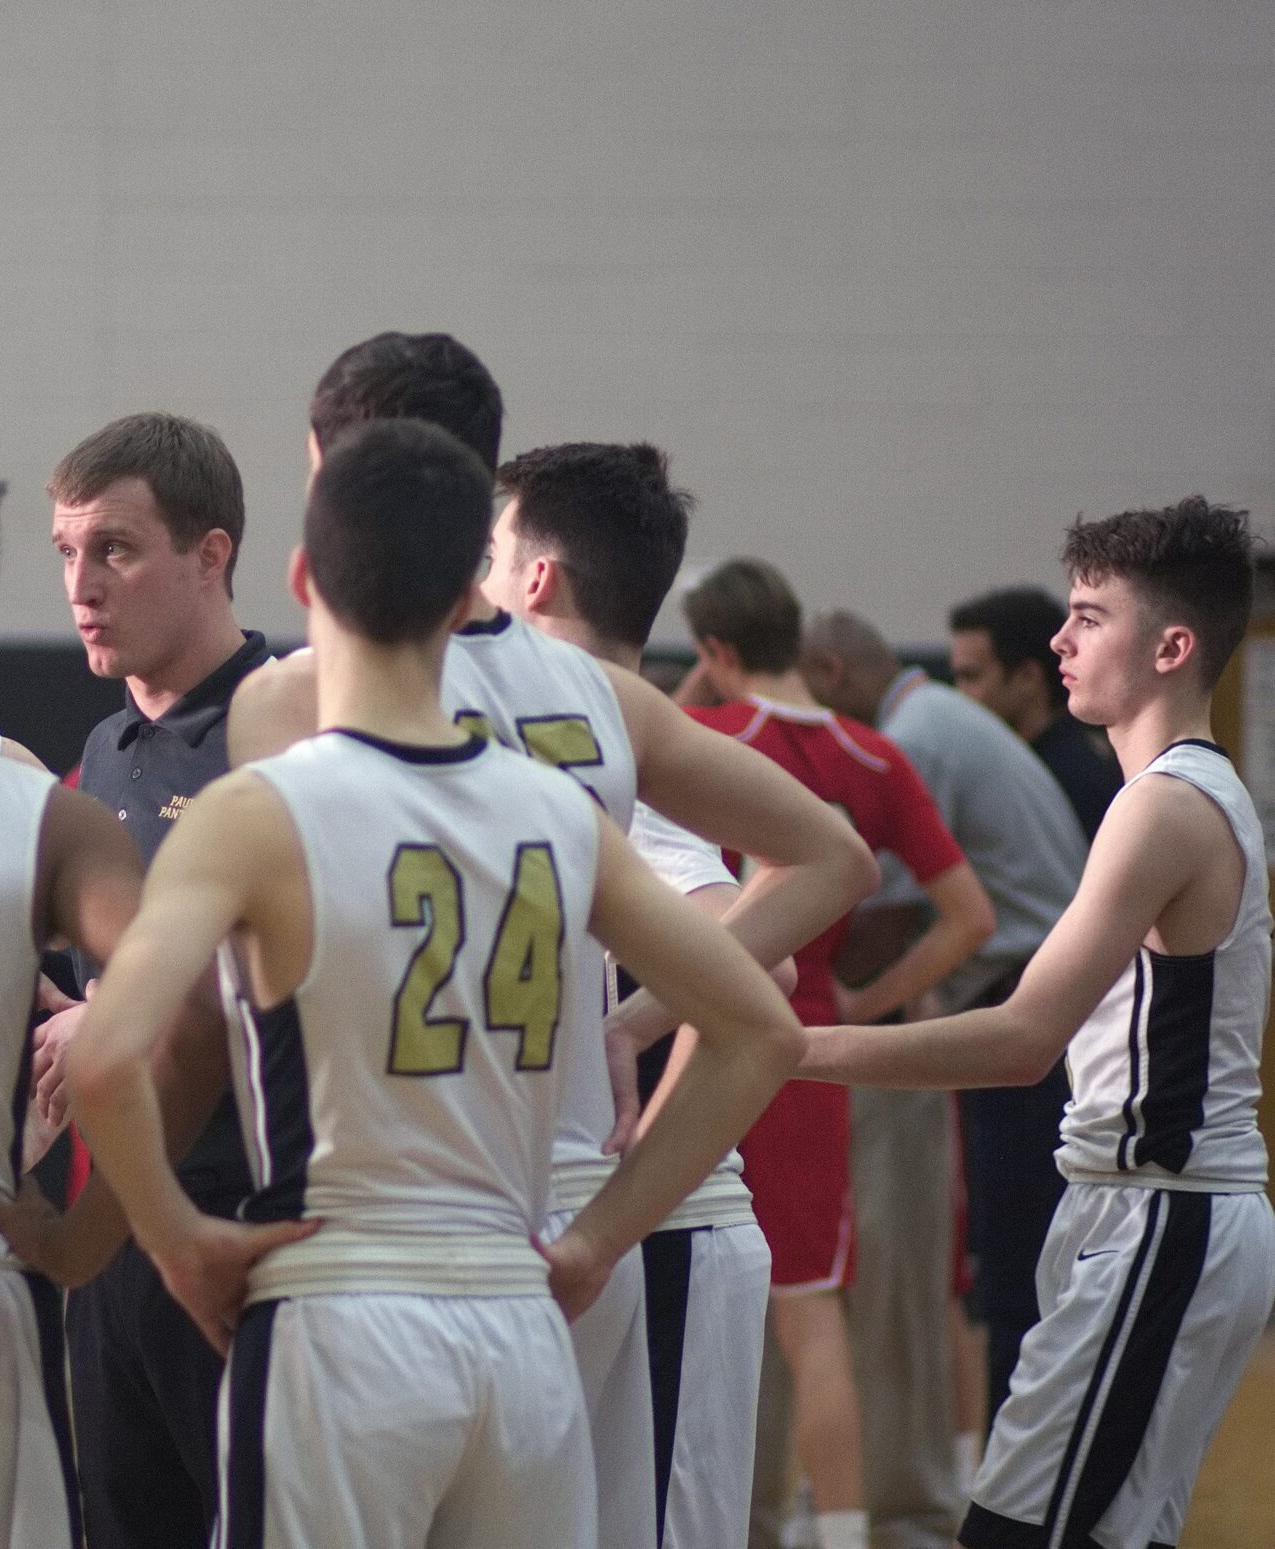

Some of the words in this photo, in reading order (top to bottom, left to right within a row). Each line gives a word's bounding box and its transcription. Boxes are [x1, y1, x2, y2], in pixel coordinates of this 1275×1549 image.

[169, 795, 194, 808] PAU
[158, 806, 184, 819] PAN
[385, 840, 566, 1076] 24
